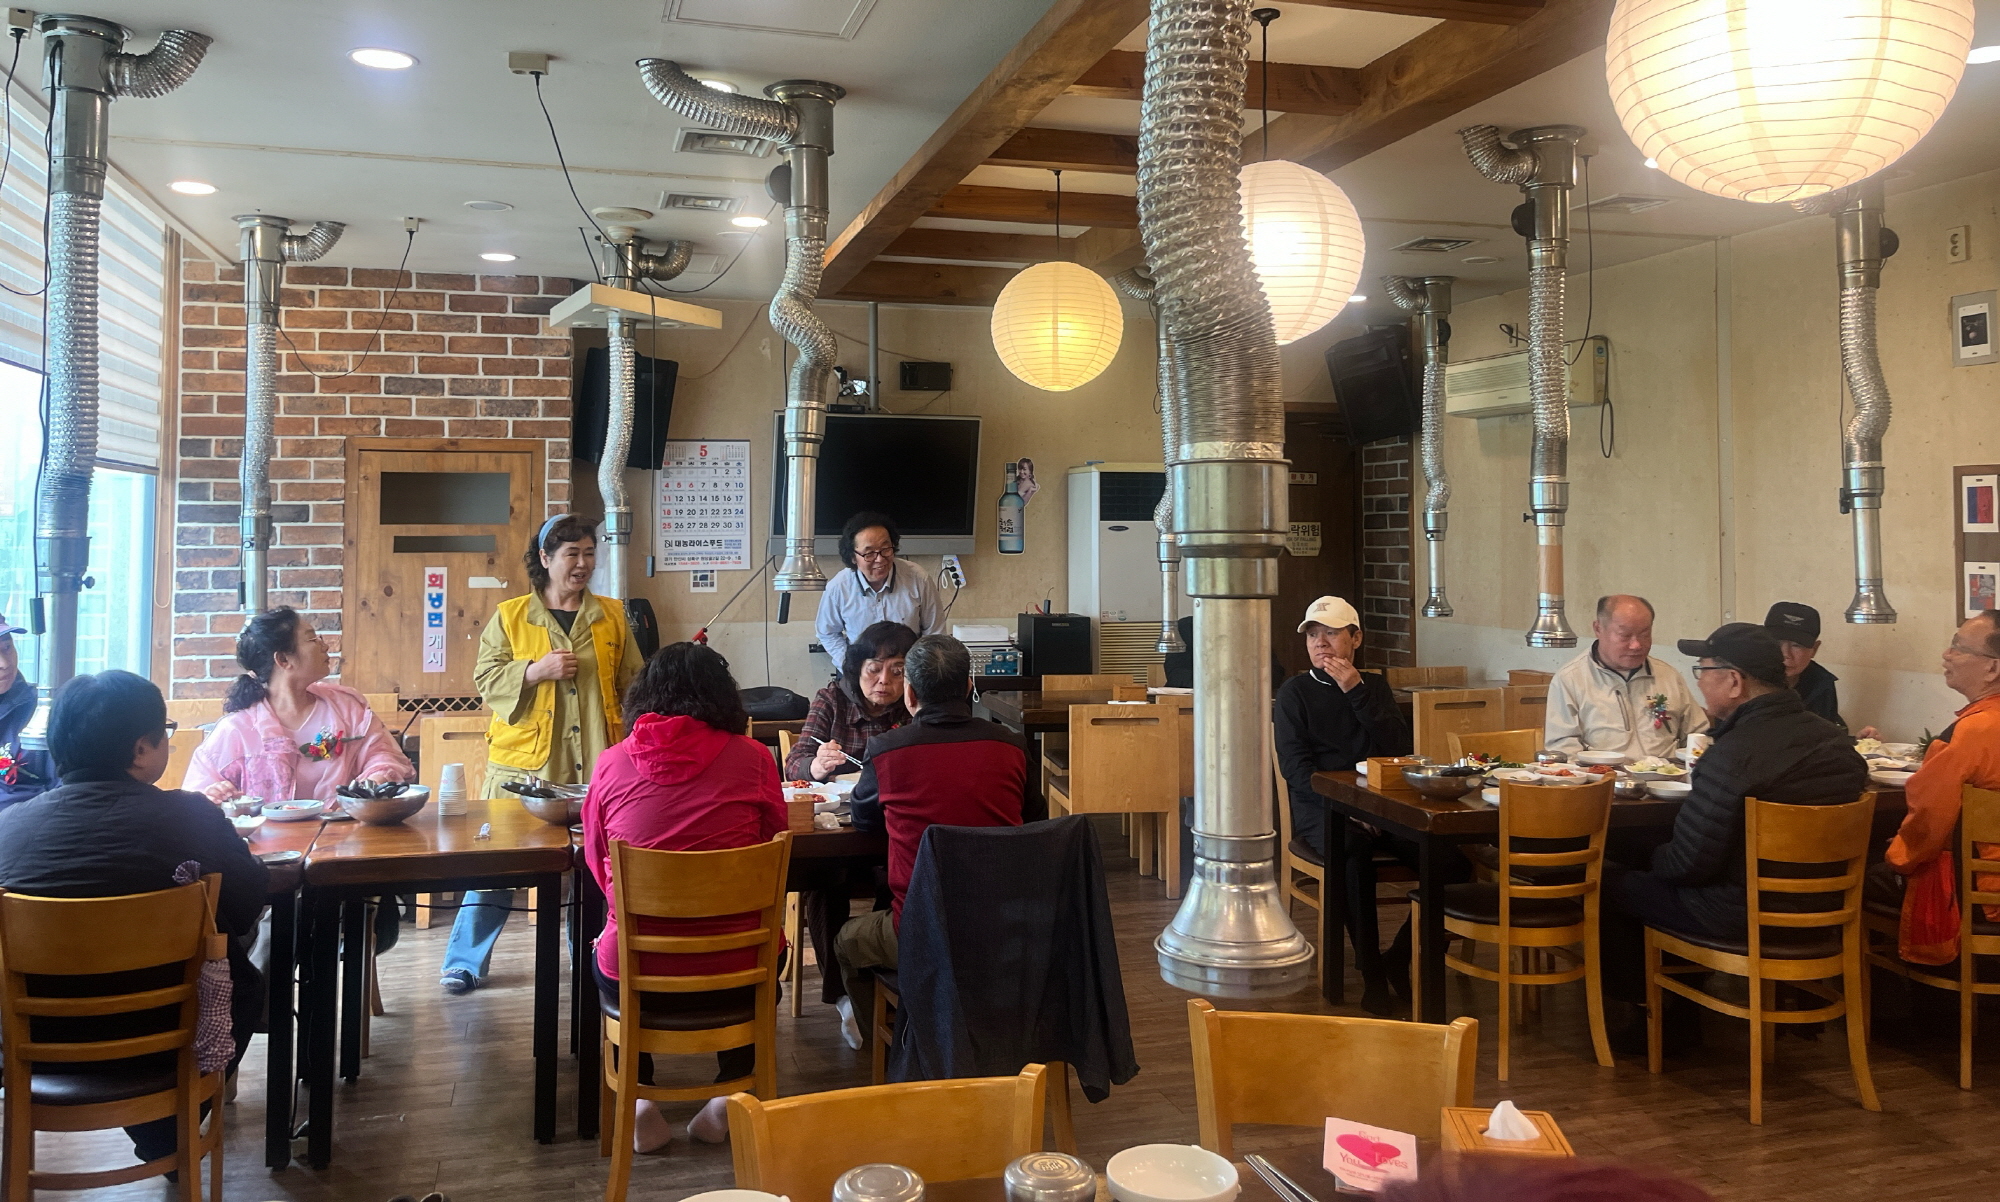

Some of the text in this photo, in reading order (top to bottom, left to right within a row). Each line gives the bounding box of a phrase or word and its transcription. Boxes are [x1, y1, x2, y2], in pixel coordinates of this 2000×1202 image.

[699, 445, 708, 457] 5
[1290, 524, 1320, 537] 락위험
[674, 540, 723, 548] 대농라이스푸드
[427, 634, 444, 667] 개시
[1339, 1151, 1409, 1169] You Loves
